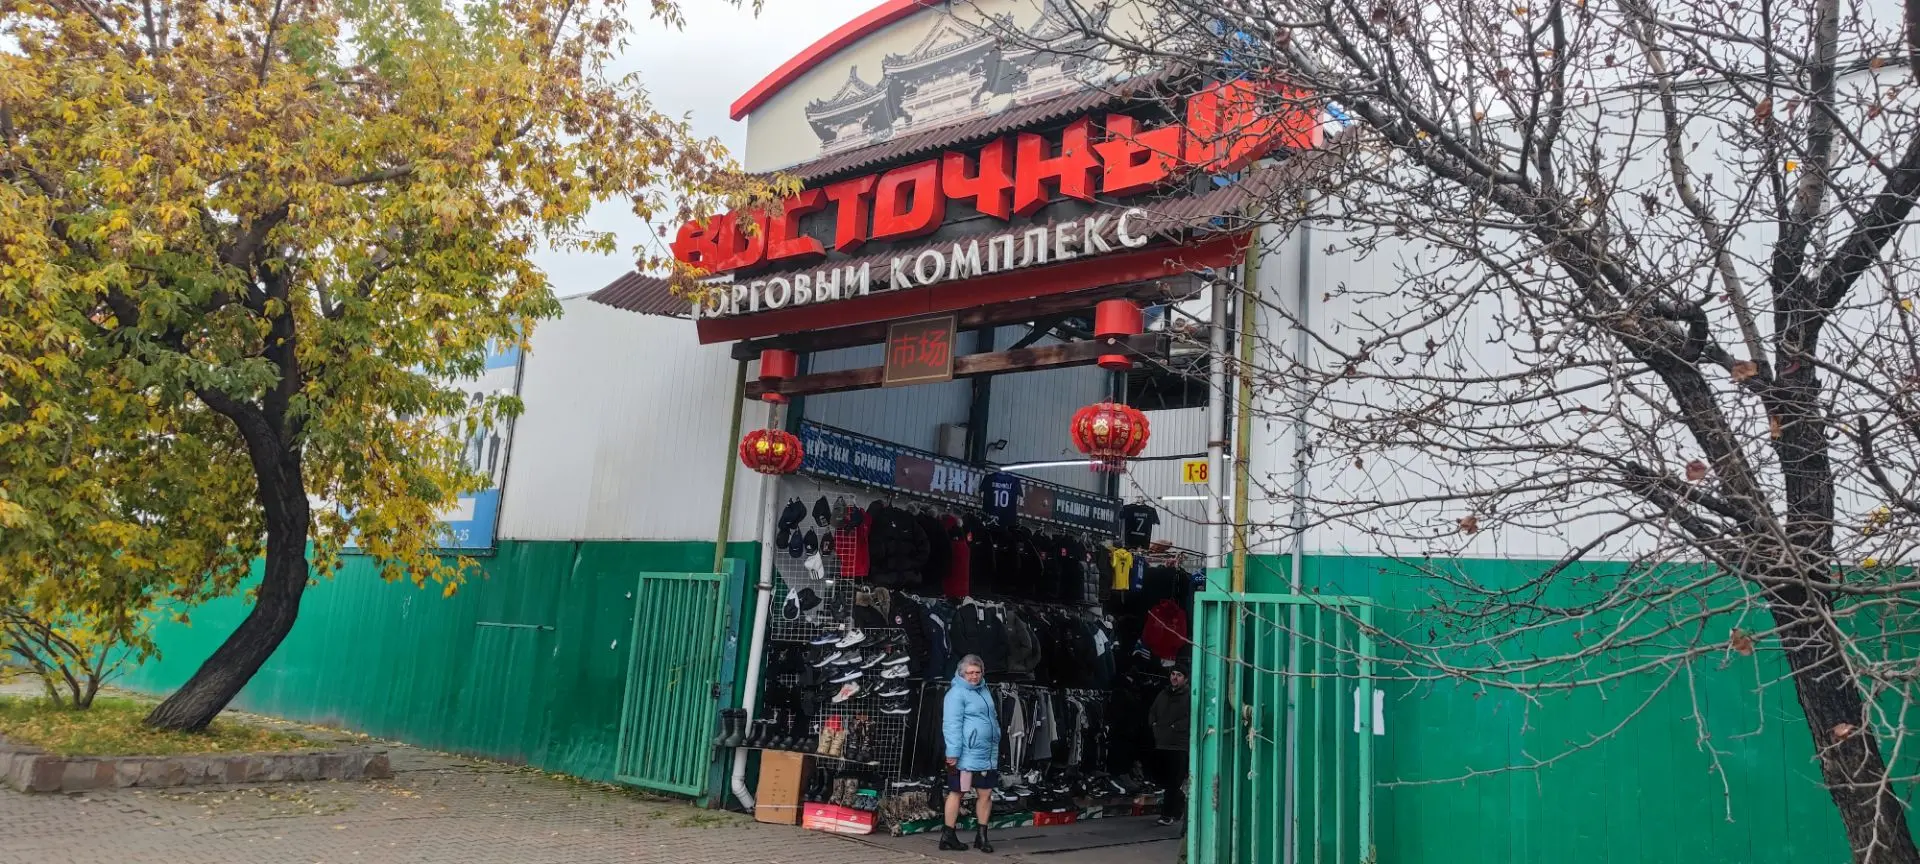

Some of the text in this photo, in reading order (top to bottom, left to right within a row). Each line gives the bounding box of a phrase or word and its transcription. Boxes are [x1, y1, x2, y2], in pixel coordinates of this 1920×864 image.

[891, 208, 1148, 290] КОМПЛЕКС
[893, 330, 948, 368] 市场
[854, 450, 891, 473] БРЮКИ
[993, 490, 1009, 508] 10
[1056, 499, 1090, 518] РУБАШКИ
[1136, 517, 1145, 532] 7
